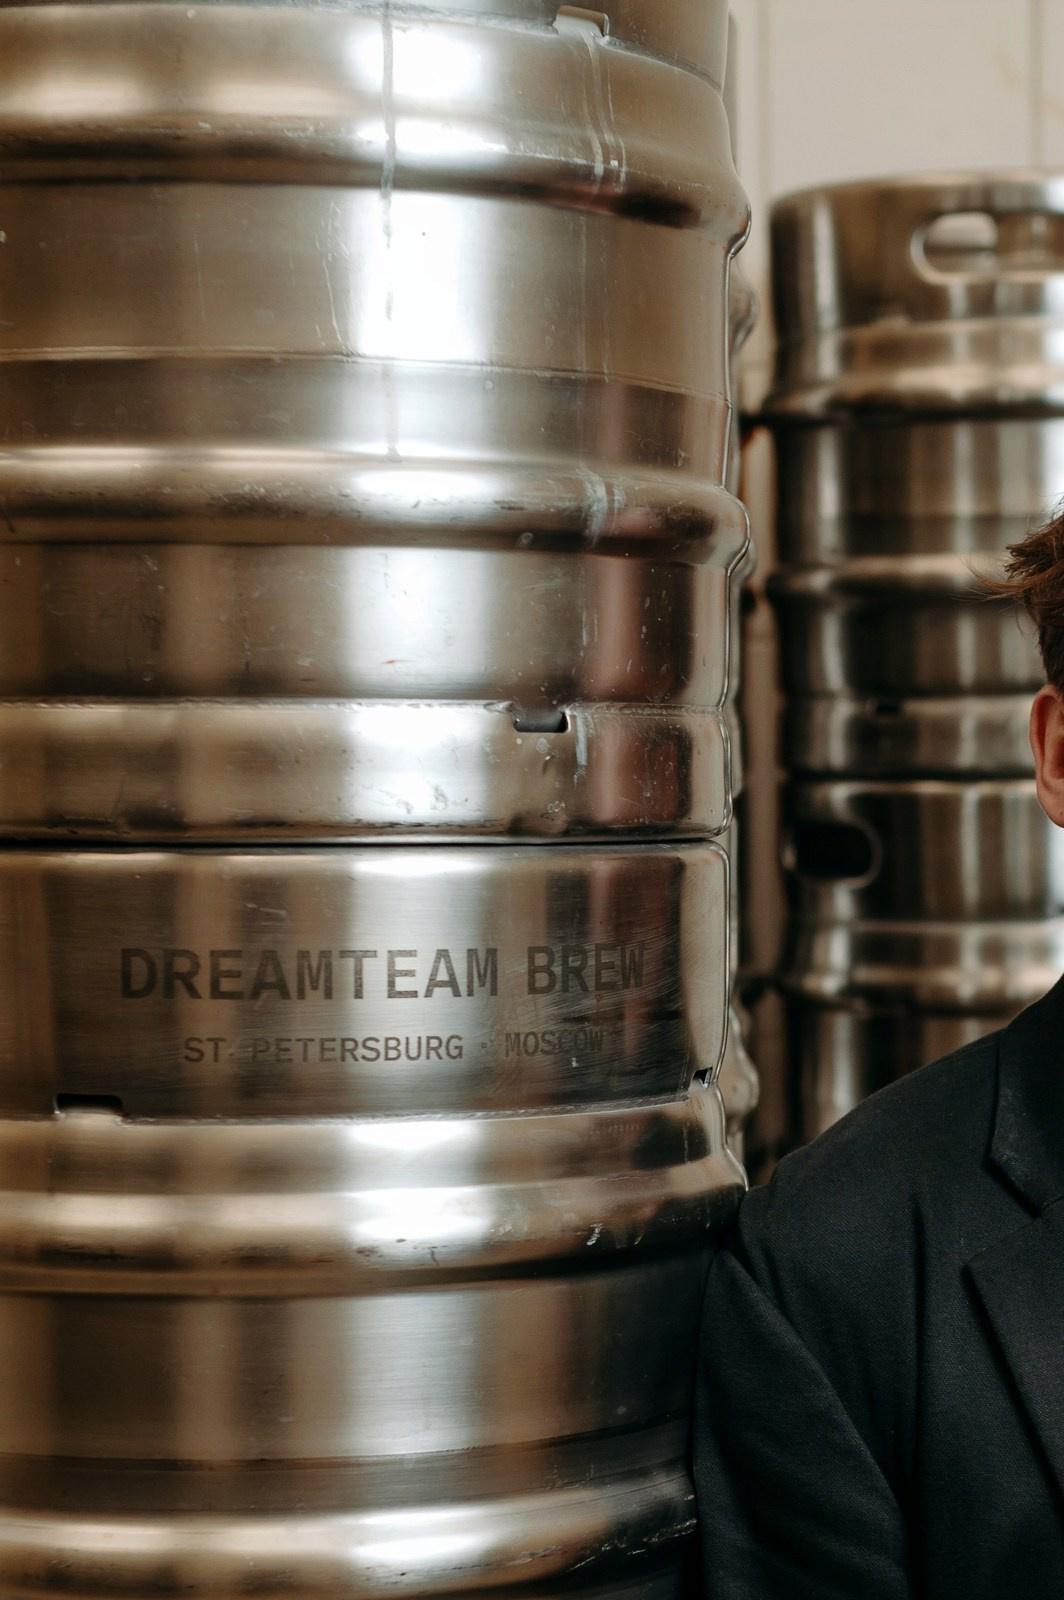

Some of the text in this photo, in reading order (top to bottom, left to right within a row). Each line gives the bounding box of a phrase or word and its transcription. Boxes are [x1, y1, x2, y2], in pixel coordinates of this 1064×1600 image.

[121, 943, 645, 1000] DREAMTEAM BREW
[250, 1034, 464, 1063] PETERSBURG
[504, 1028, 605, 1058] MOSCOW
